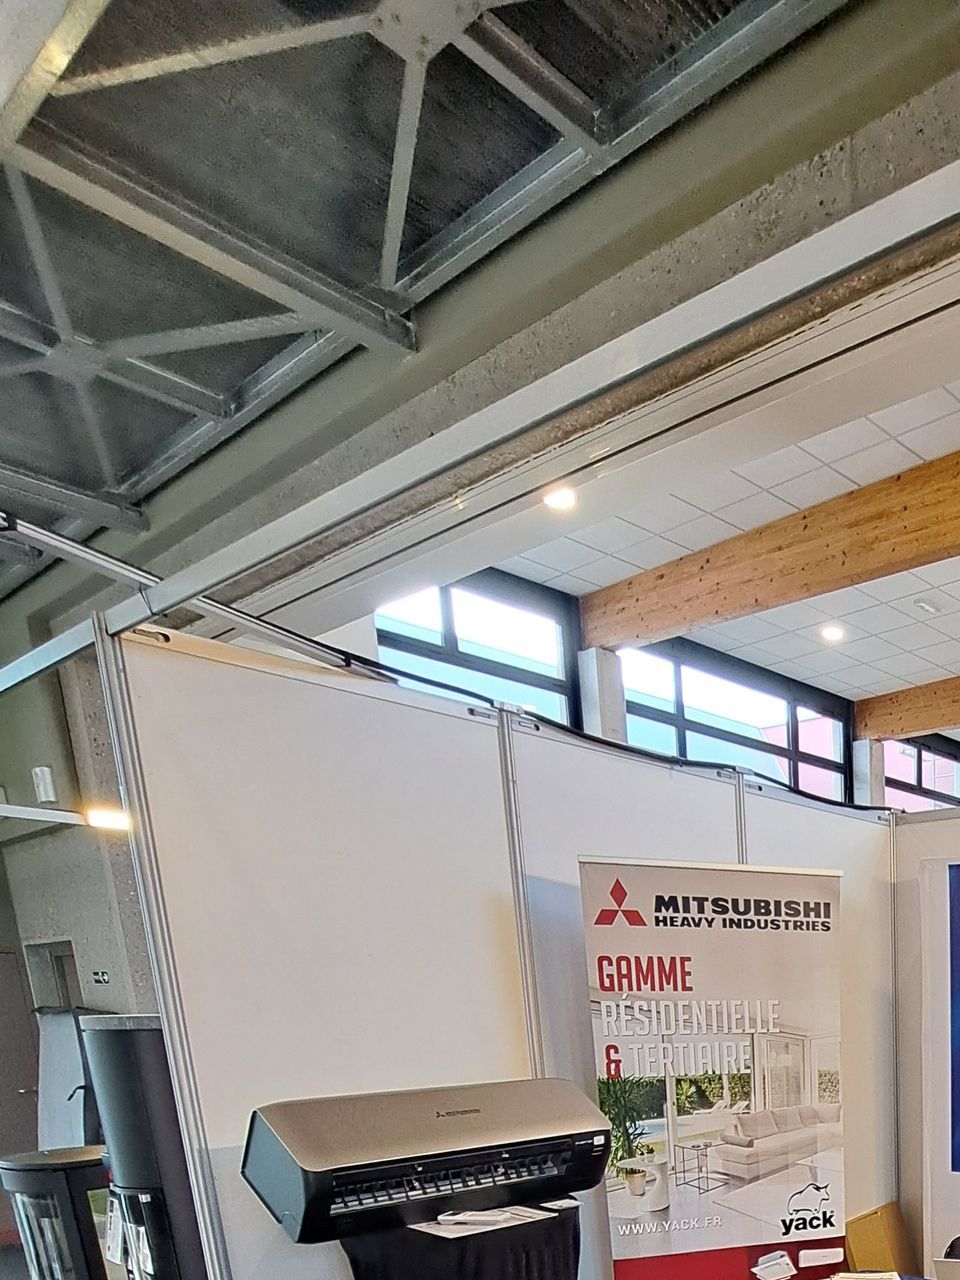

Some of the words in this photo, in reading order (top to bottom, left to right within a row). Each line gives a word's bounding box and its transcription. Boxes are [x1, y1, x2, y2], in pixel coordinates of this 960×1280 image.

[654, 895, 831, 919] MITSUBISHI
[655, 916, 715, 929] HEAVY
[722, 917, 831, 932] INDUSTRIES
[597, 955, 693, 992] GAMME
[601, 993, 781, 1036] RÉSIDENTIELLE
[605, 1044, 622, 1081] &
[628, 1041, 752, 1077] TERTIAIRE
[618, 1215, 722, 1236] WWW.YACK.FR
[781, 1211, 835, 1236] yack
